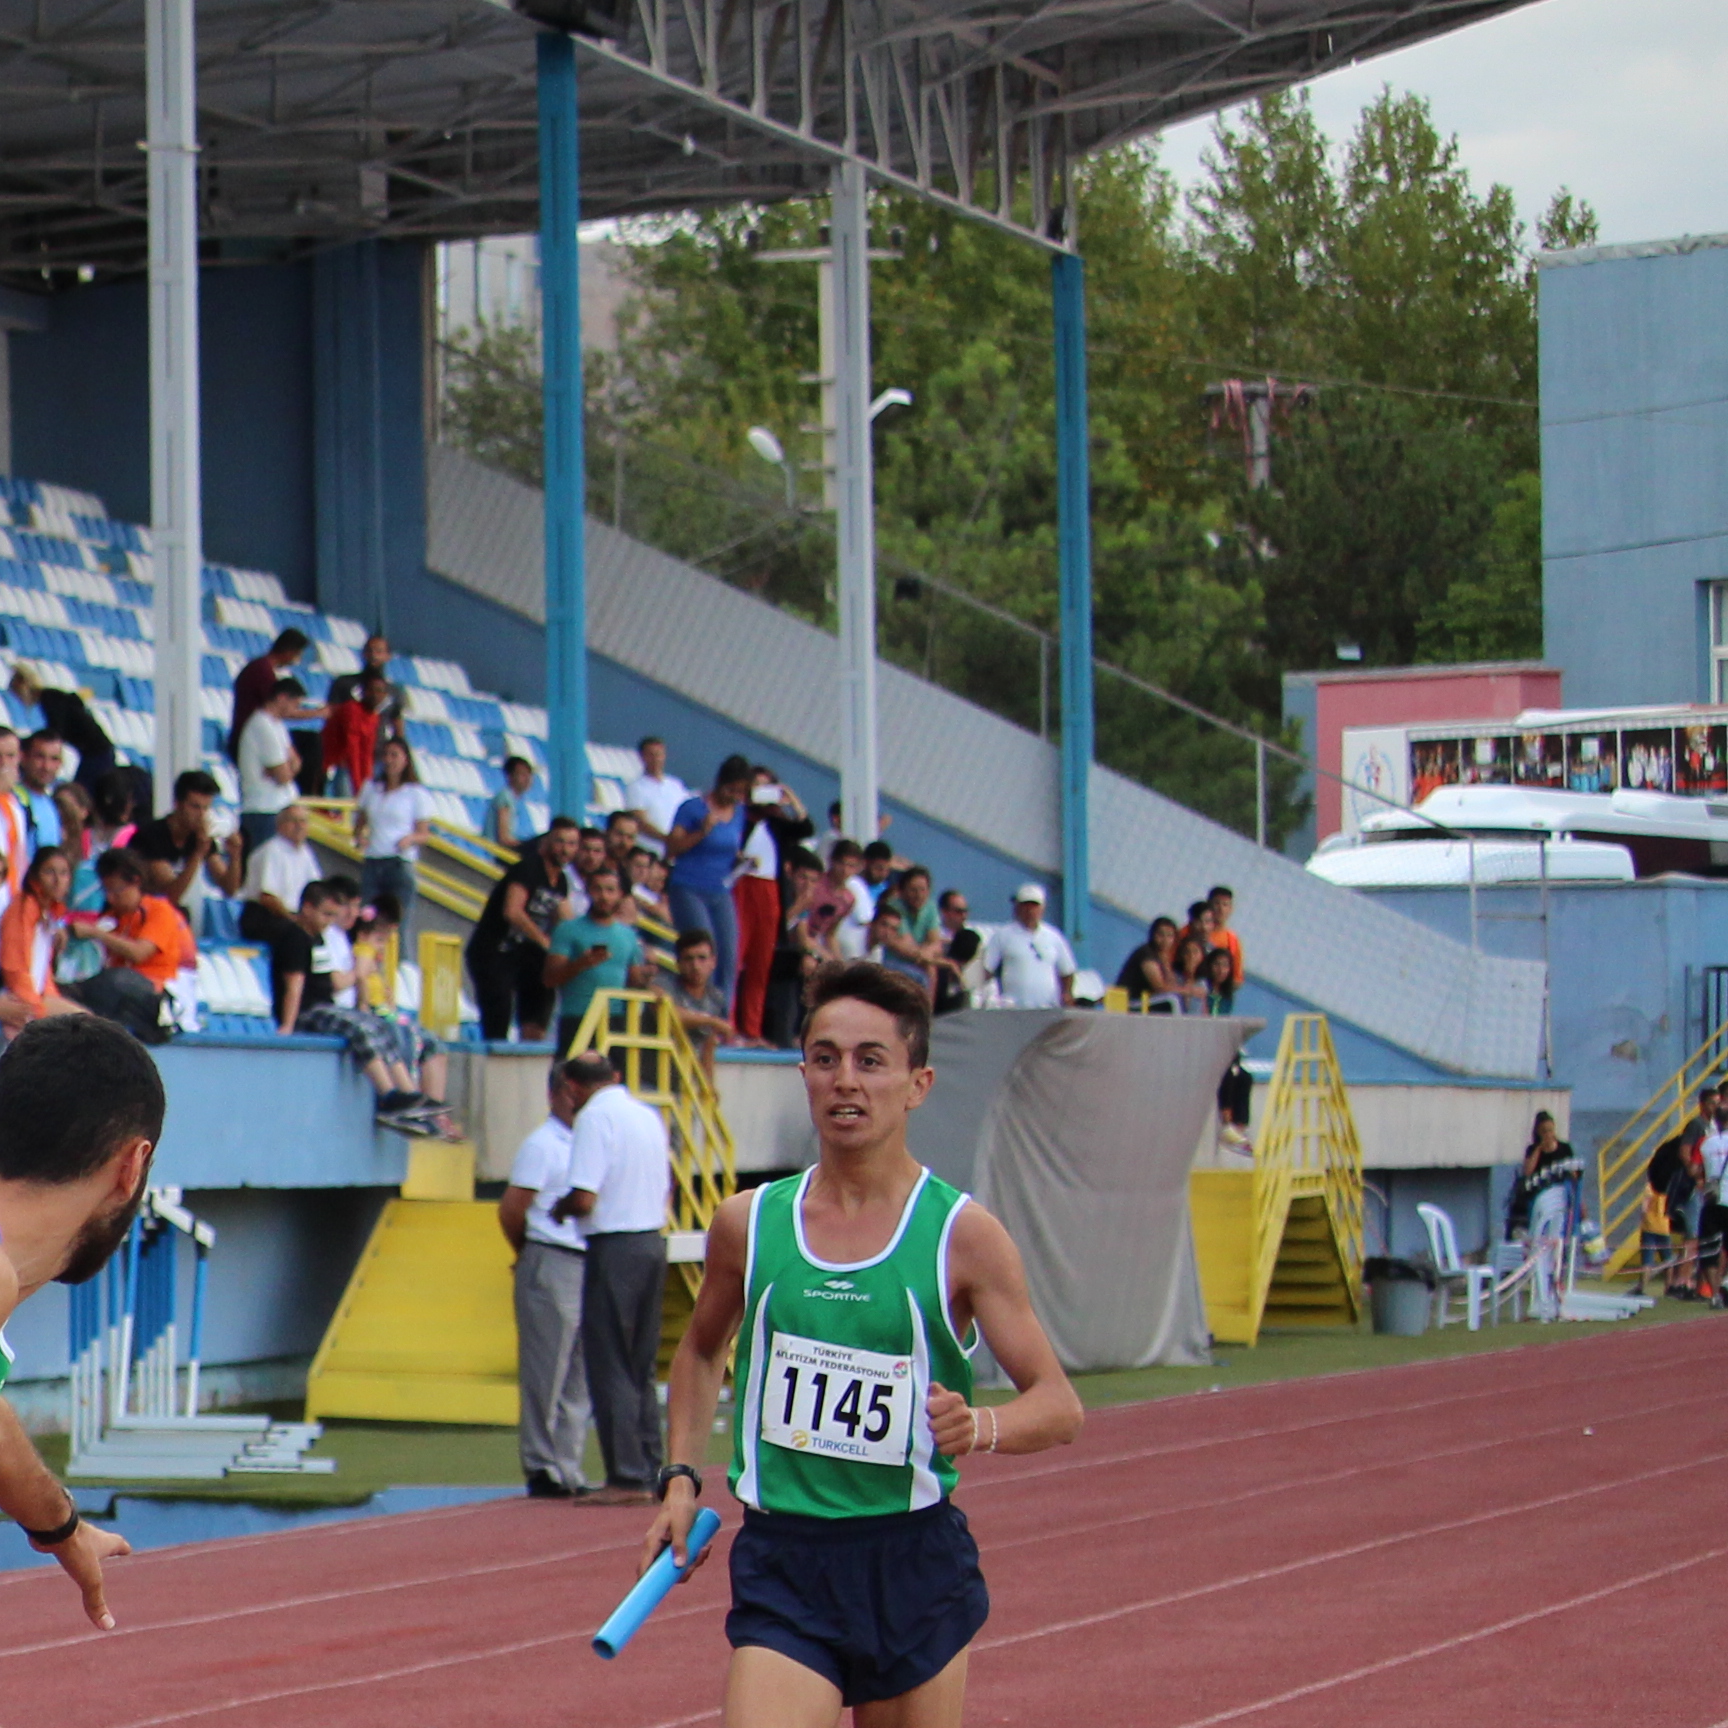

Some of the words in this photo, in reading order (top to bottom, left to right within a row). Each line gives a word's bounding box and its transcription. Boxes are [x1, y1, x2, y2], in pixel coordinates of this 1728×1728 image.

[802, 1288, 871, 1302] SPORTIVE
[813, 1345, 853, 1361] TÜRKİYE
[819, 1359, 890, 1380] FEDERASYONU
[782, 1365, 894, 1442] 1145
[811, 1436, 869, 1456] TURKCELL
